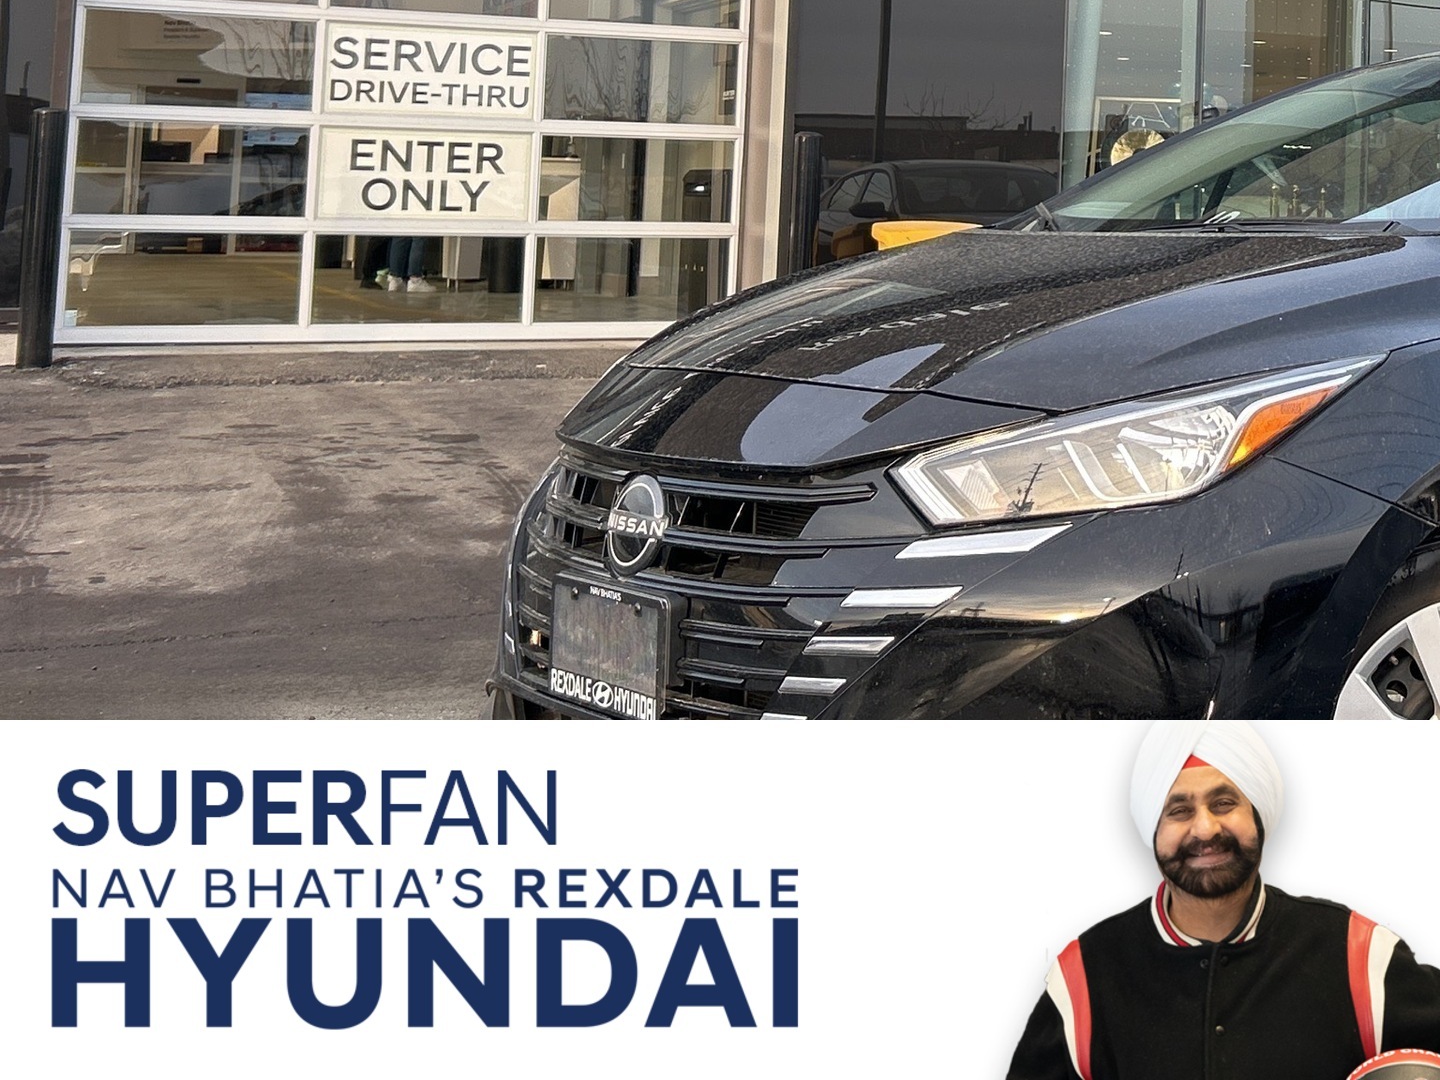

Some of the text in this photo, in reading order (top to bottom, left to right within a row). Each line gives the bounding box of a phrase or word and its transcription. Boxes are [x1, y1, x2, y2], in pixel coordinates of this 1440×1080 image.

[330, 36, 532, 77] SERVICE
[329, 78, 530, 109] DRIVE-THRU
[350, 138, 505, 175] ENTER
[361, 177, 491, 213] ONLY
[607, 512, 666, 537] NISSAN
[550, 667, 657, 720] REXDALE HYUNDAI
